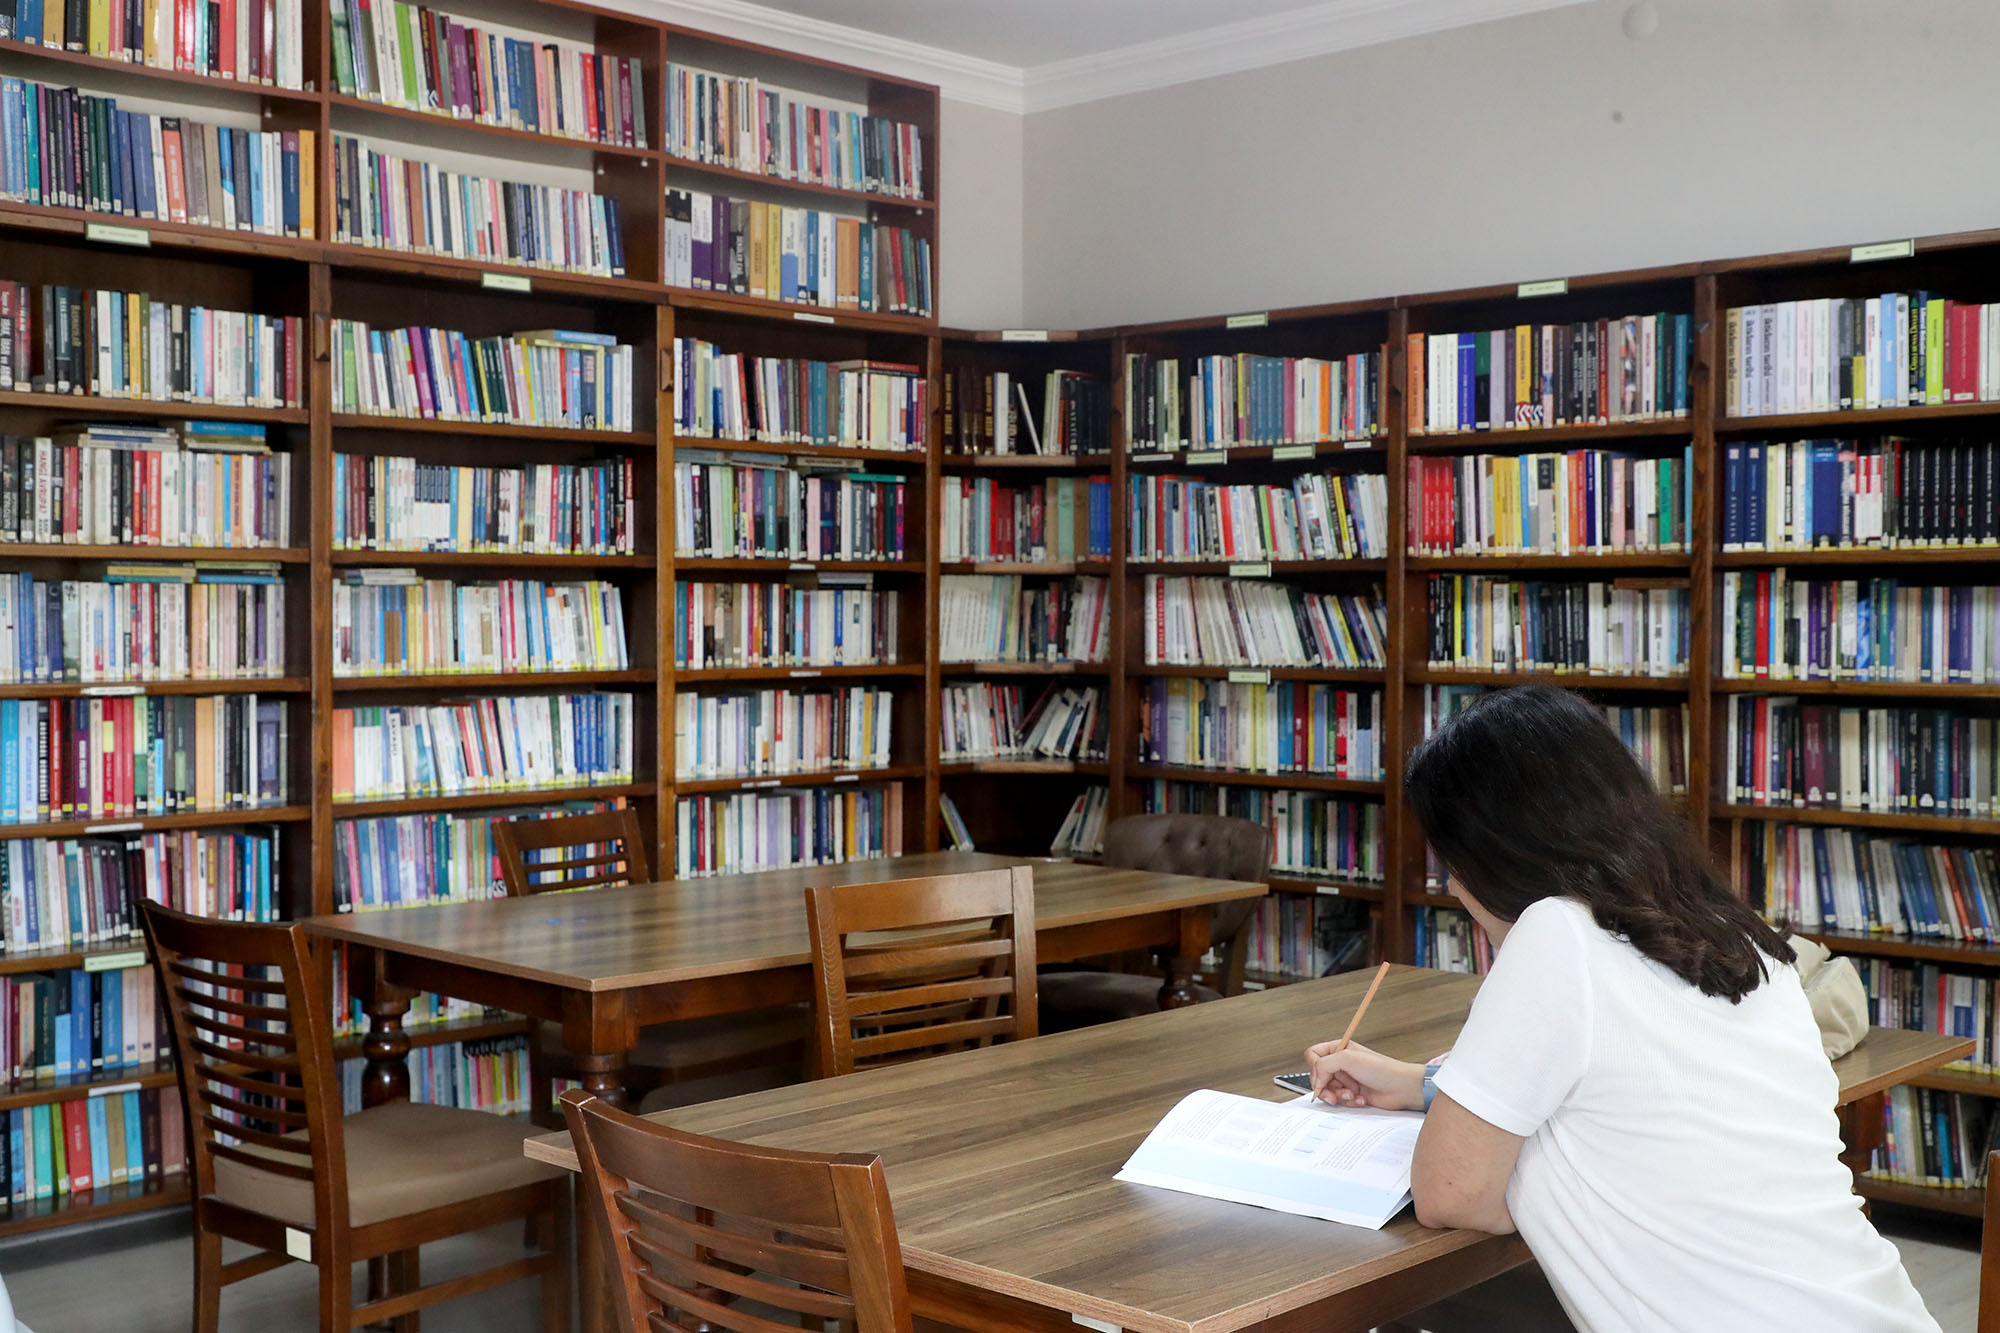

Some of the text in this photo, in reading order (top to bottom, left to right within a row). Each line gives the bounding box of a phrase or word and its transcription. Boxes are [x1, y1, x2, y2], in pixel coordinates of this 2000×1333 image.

[1728, 321, 1737, 380] iktidarın tarihi
[1746, 320, 1754, 378] iktidarın tarihi
[1764, 354, 1773, 376] tarihi
